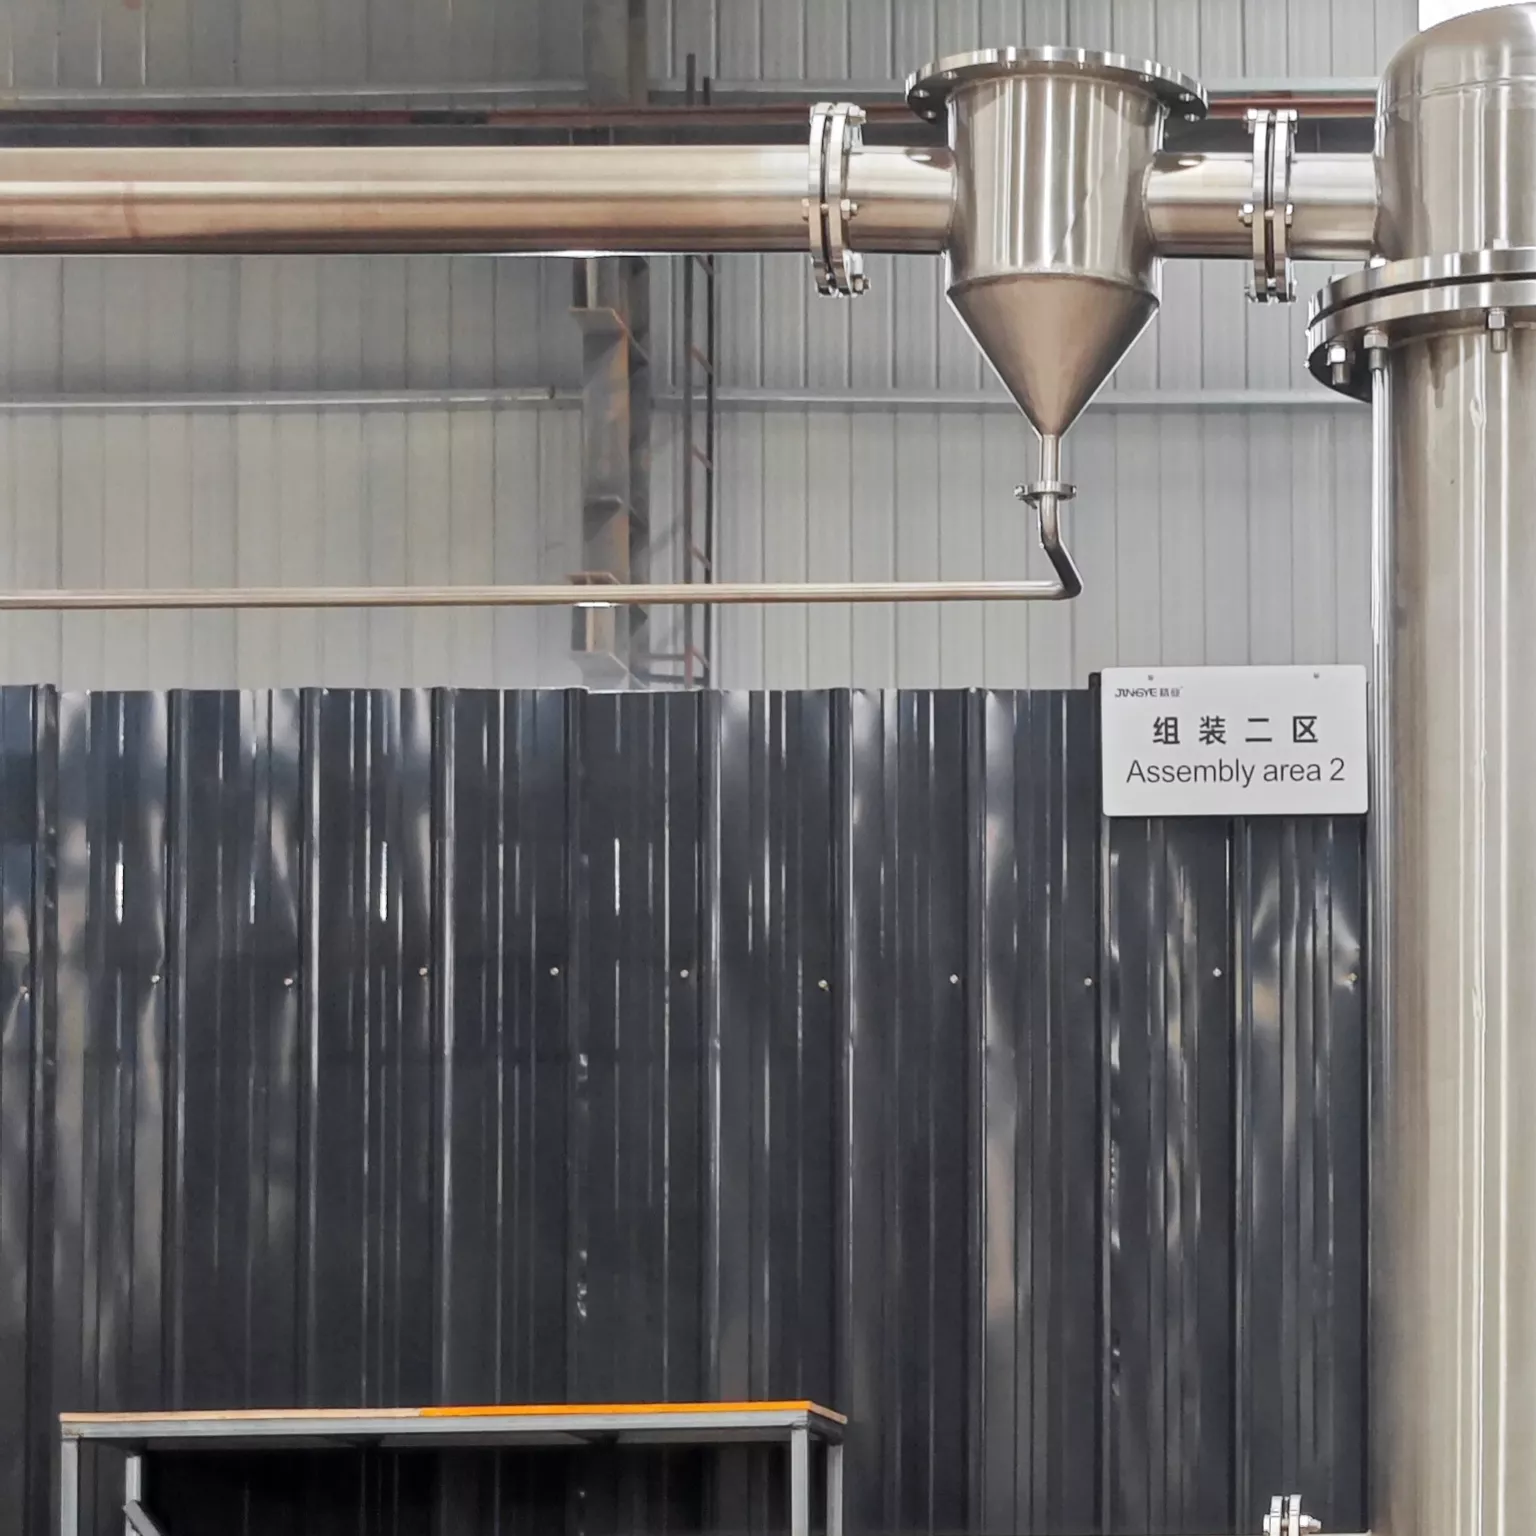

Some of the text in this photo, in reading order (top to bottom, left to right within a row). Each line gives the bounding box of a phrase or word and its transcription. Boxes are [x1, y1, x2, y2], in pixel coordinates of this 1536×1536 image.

[1114, 687, 1158, 698] JINGYE
[1152, 715, 1319, 745] 组装二区
[1126, 757, 1346, 788] Assembly area 2
